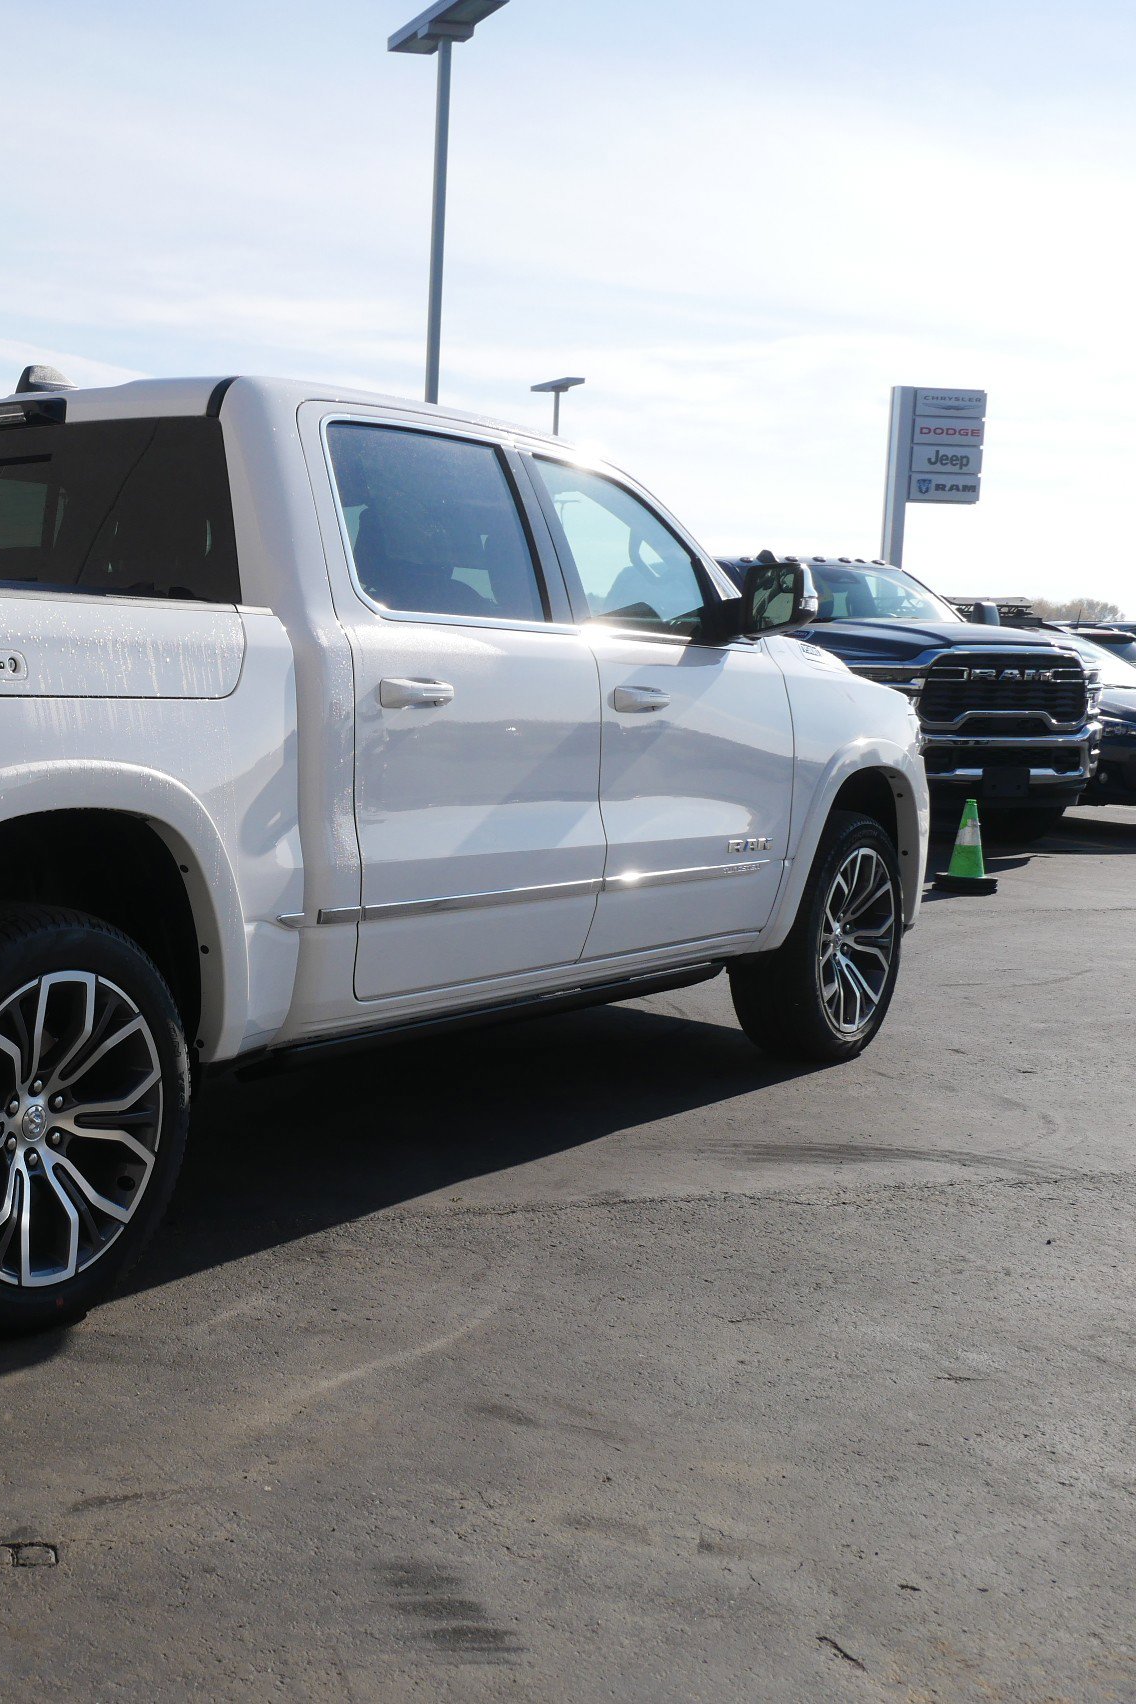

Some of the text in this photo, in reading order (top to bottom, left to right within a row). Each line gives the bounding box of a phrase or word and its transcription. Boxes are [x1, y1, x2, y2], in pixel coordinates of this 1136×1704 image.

[923, 395, 982, 403] CHRYSLER
[919, 426, 981, 437] DODGE
[927, 449, 970, 470] Jeep
[934, 483, 977, 493] RAM
[970, 668, 1051, 681] RAM
[727, 838, 773, 853] RAM
